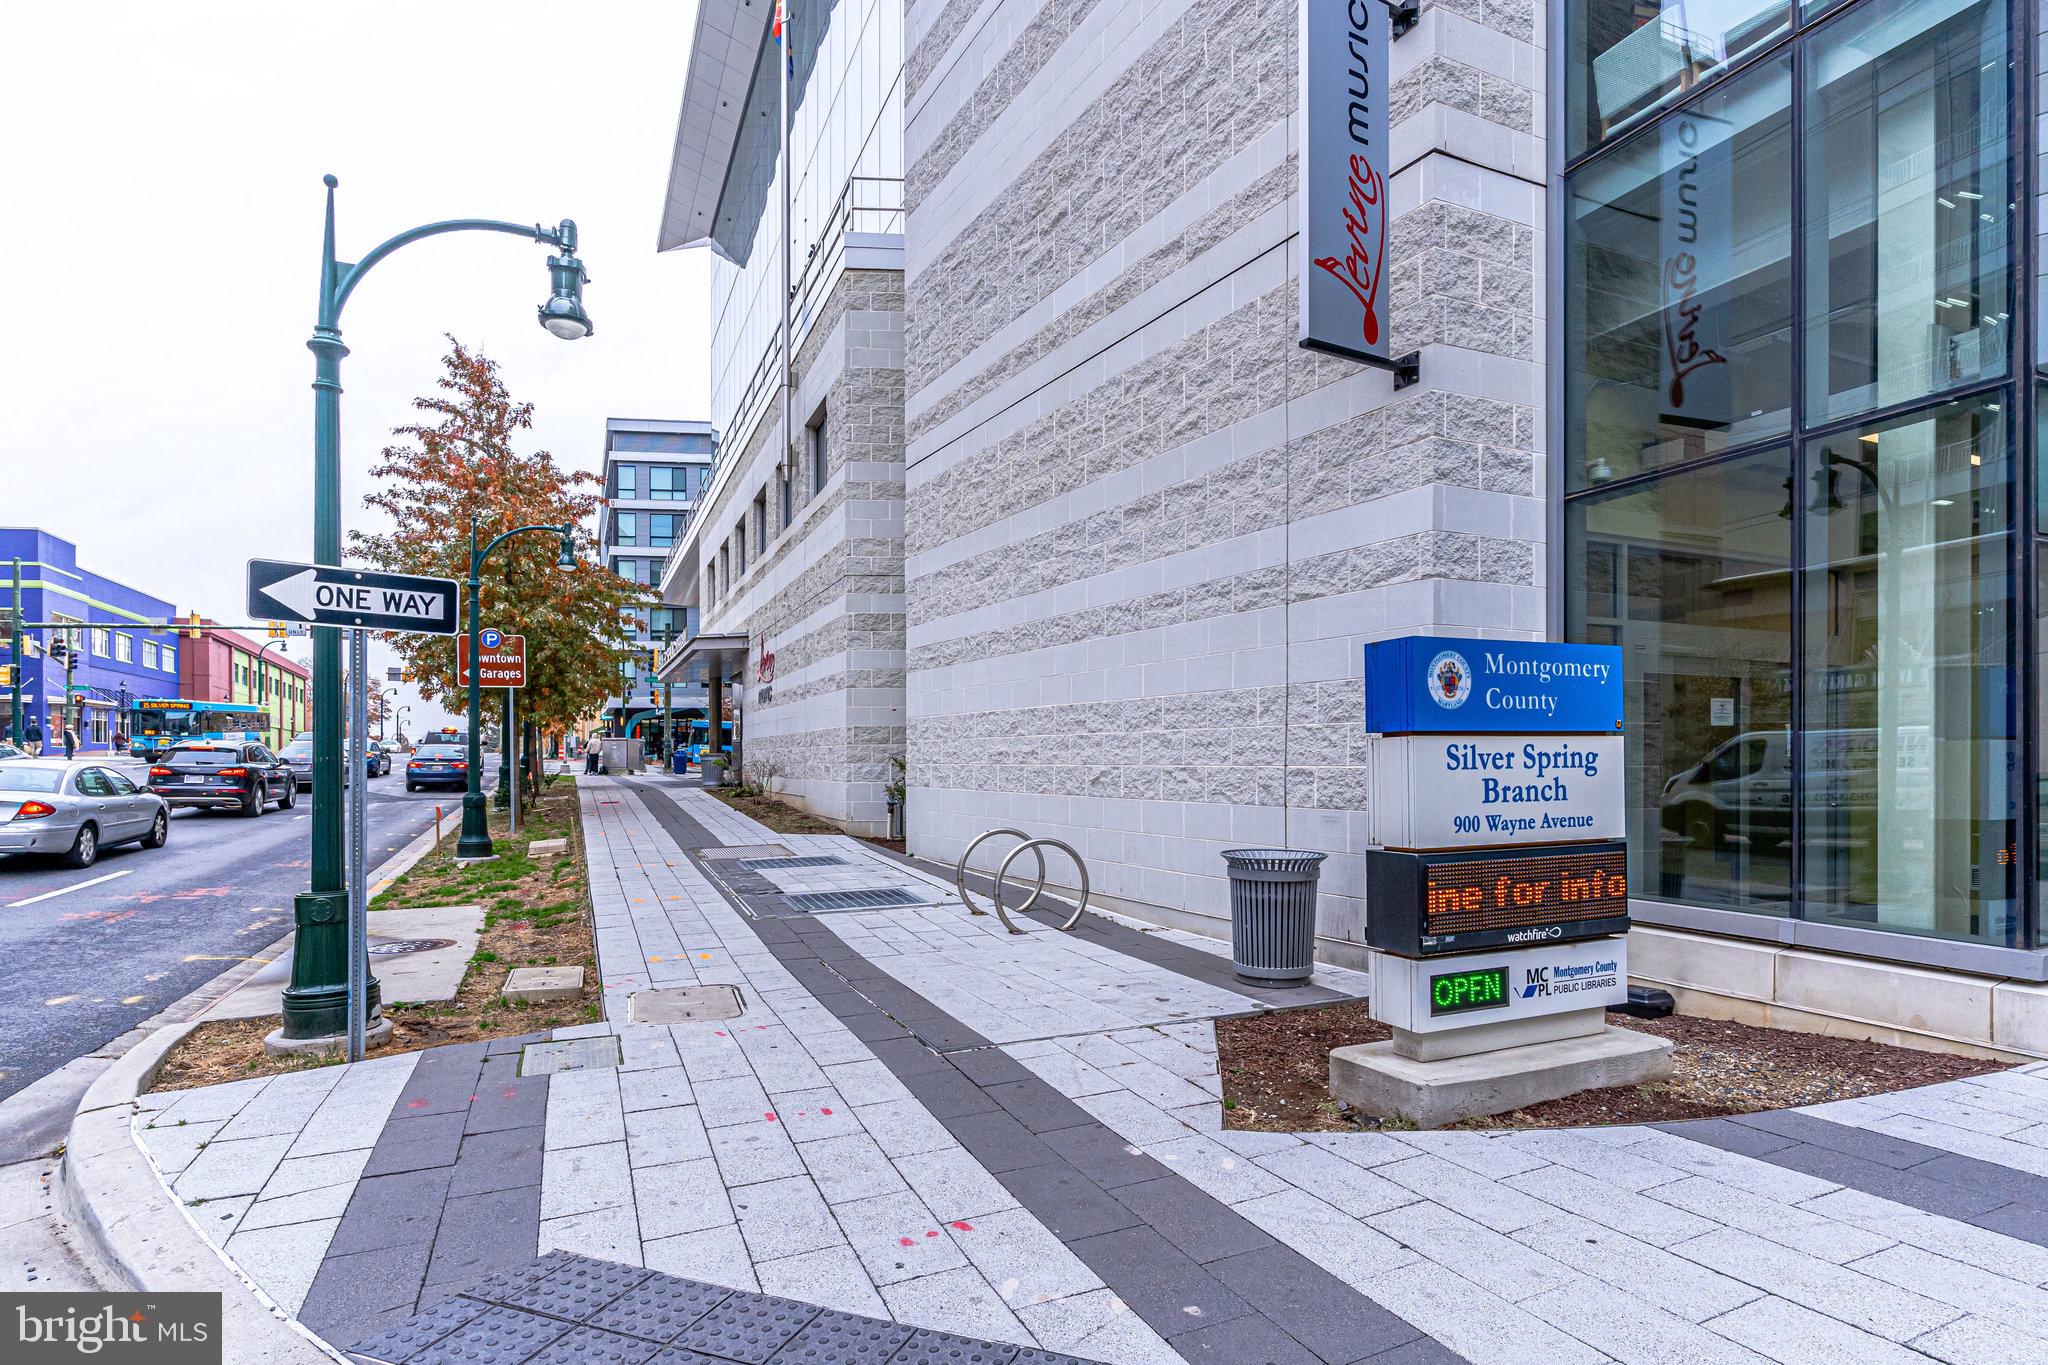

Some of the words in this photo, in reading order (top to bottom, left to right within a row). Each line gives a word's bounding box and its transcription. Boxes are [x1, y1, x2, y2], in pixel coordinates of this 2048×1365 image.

[316, 585, 371, 610] ONE
[383, 591, 437, 616] WAY
[486, 633, 498, 646] P
[480, 668, 522, 680] Garages
[1485, 652, 1610, 685] Montgomery
[1485, 687, 1558, 717] County
[1446, 743, 1514, 771] Silver
[1523, 743, 1599, 778] Spring
[1482, 776, 1568, 804] Branch
[1453, 815, 1480, 834] 900
[1485, 814, 1536, 836] Wayne
[1539, 812, 1594, 829] Avenue
[1495, 875, 1551, 907] for
[1561, 868, 1626, 901] info
[1507, 928, 1547, 943] watchfire
[1526, 967, 1549, 984] MC
[1553, 964, 1594, 978] Montgomery
[1595, 960, 1618, 973] County
[1435, 972, 1501, 1008] OPEN
[1538, 984, 1552, 997] PL
[1553, 983, 1580, 995] PUBLIC
[1581, 977, 1617, 991] LIBRARIES
